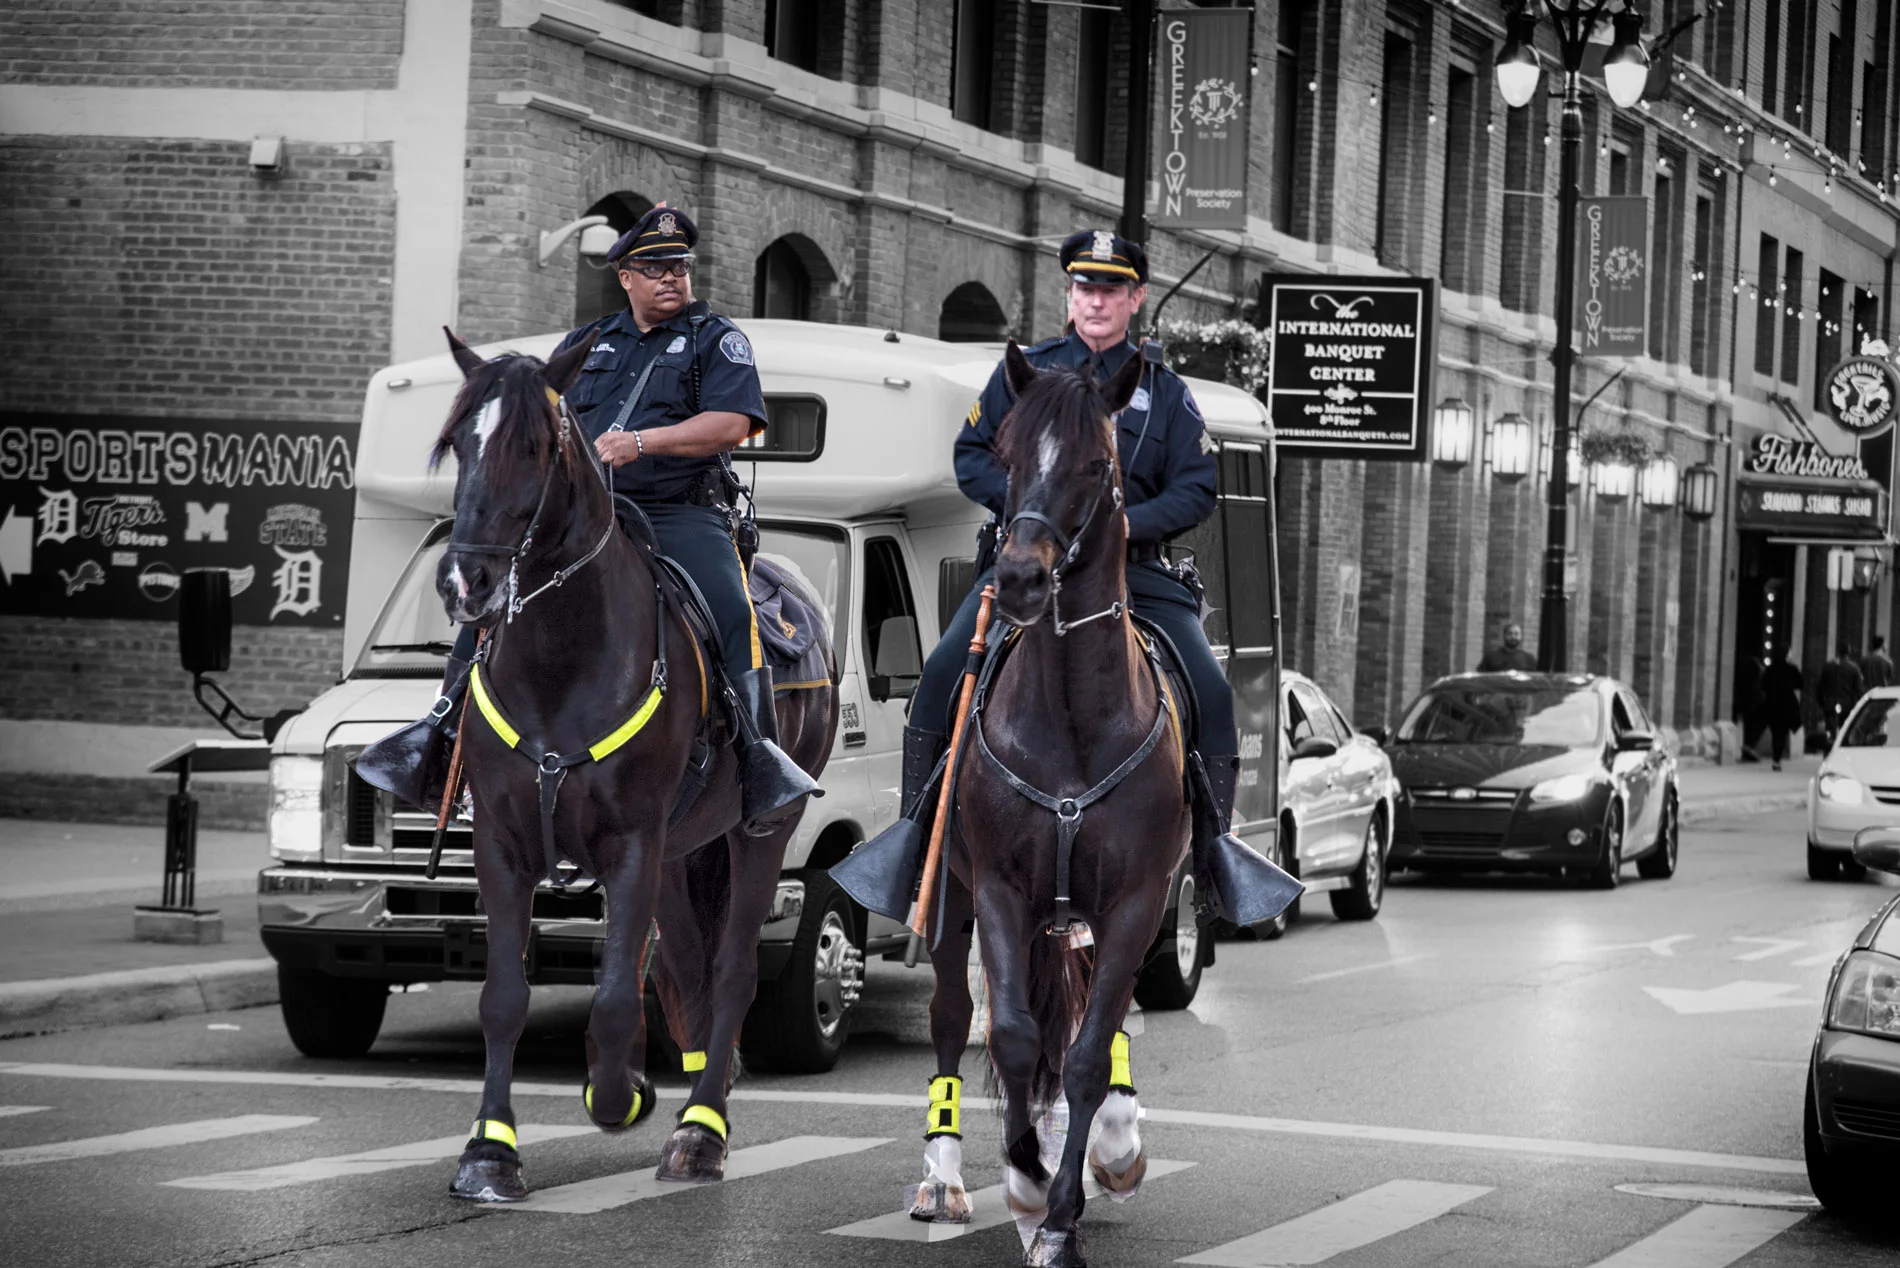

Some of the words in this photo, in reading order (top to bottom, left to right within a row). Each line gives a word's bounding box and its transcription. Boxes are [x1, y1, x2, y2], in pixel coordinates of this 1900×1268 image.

[1165, 21, 1186, 217] GREEKTOWN
[1186, 188, 1242, 198] Preservation
[1197, 198, 1232, 209] Society
[1585, 205, 1602, 348] GREEKTOWN
[1278, 320, 1415, 338] INTERNATIONAL
[1304, 343, 1386, 362] BANQUET
[1309, 366, 1376, 382] CENTER
[1304, 404, 1323, 415] 400
[1324, 403, 1362, 415] Monroe
[1334, 415, 1361, 426] Floor
[0, 427, 198, 486] SPORTS
[203, 432, 355, 489] MANIA
[185, 501, 230, 542] M
[118, 530, 168, 547] Store
[259, 519, 327, 546] STATE
